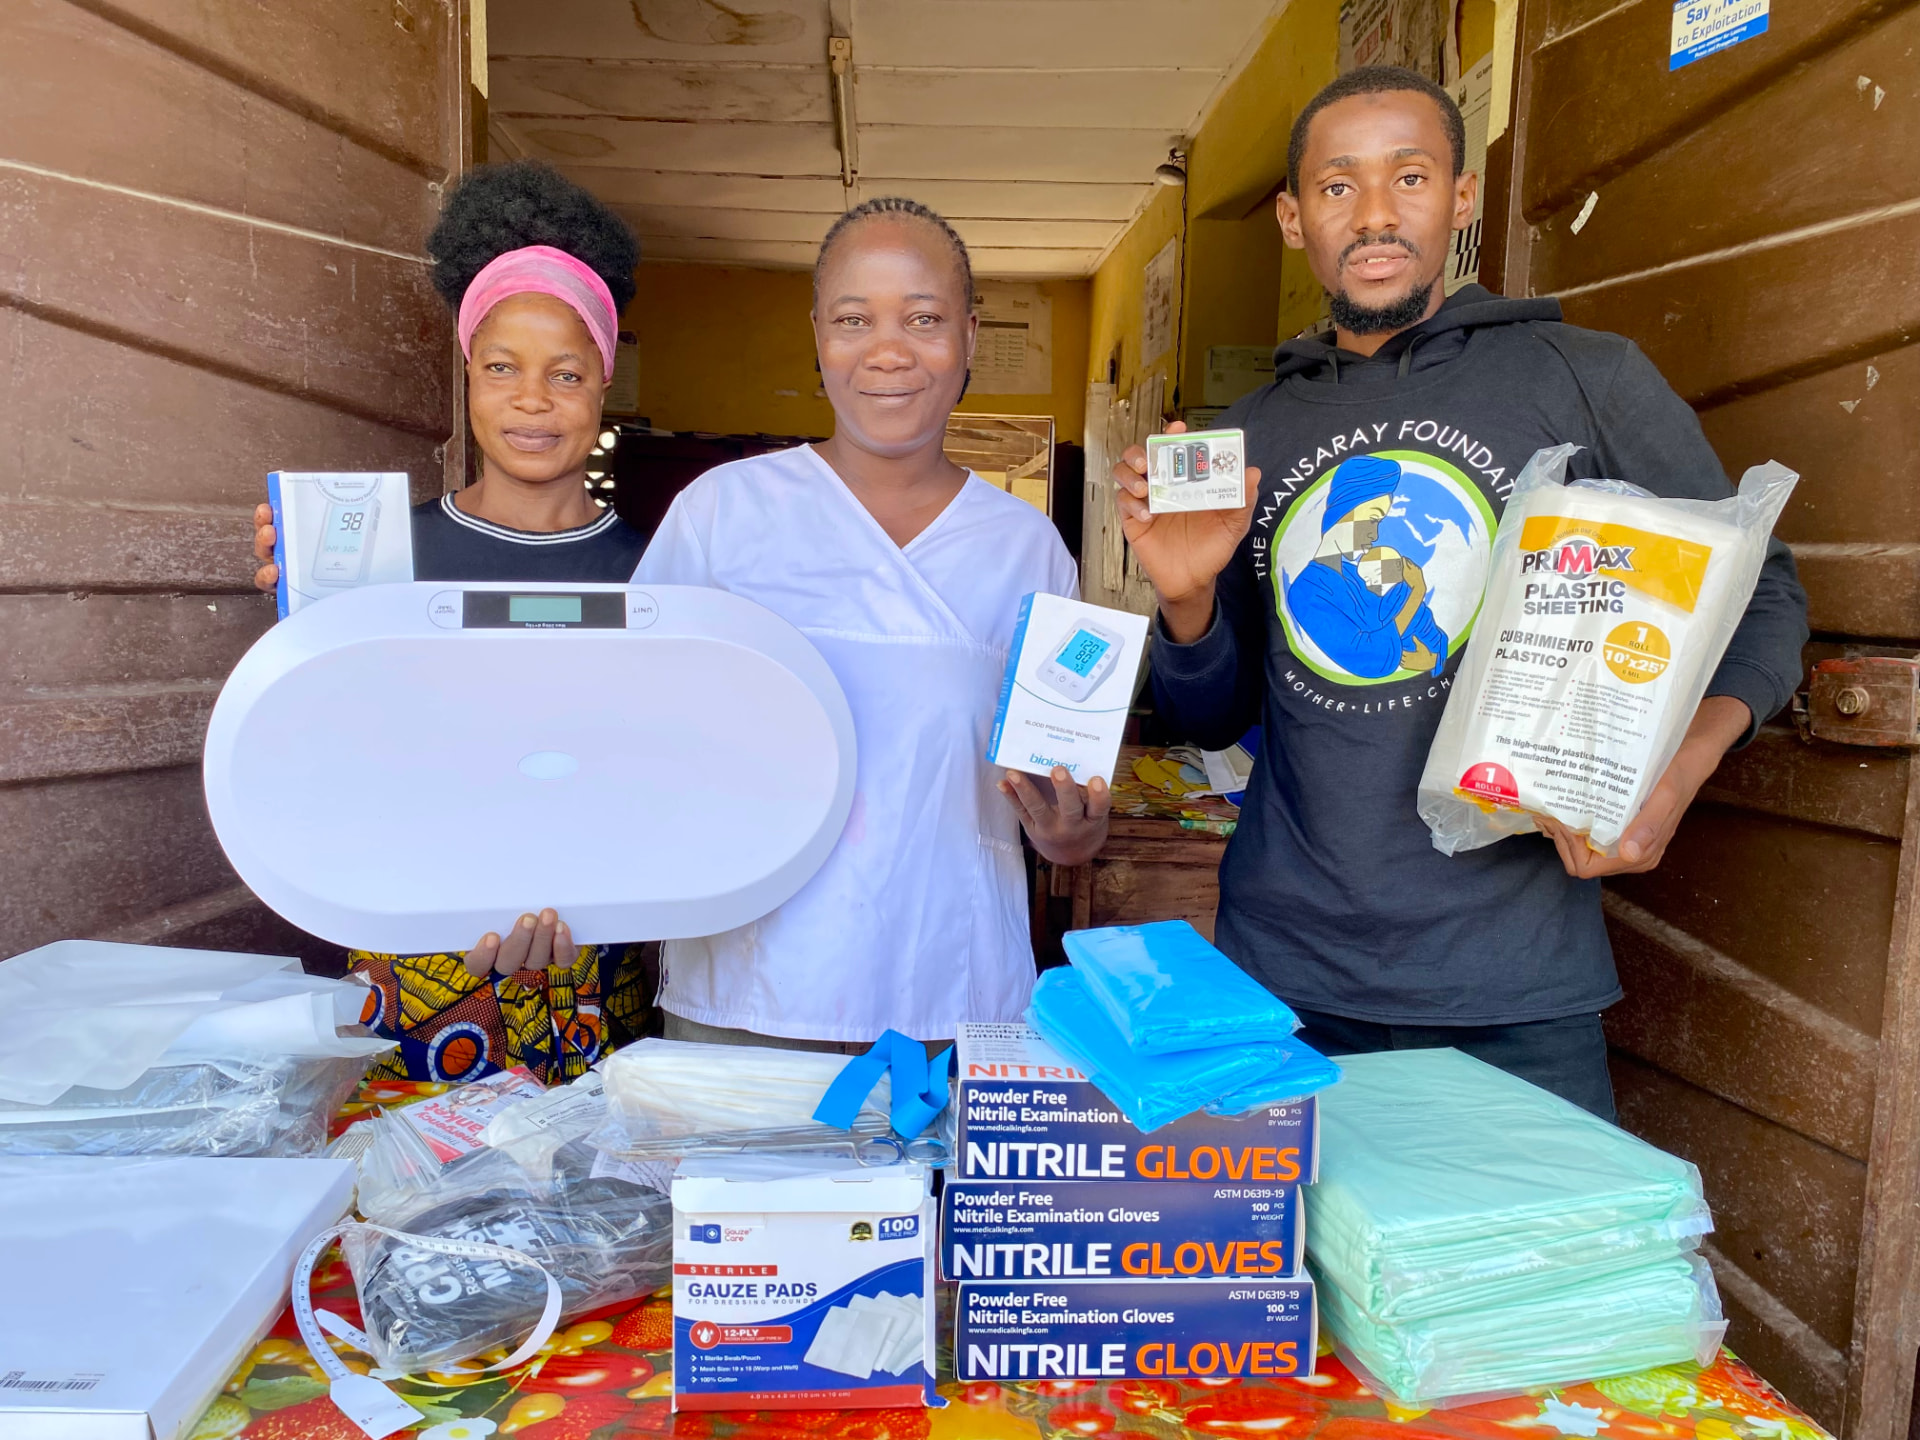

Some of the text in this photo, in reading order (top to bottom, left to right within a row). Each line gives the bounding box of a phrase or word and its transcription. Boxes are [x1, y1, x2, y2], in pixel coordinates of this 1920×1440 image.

[1686, 4, 1711, 25] Say
[1677, 35, 1689, 47] to
[1692, 2, 1761, 39] Exploitation
[1257, 422, 1389, 528] MANSARAY
[1254, 537, 1266, 580] THE
[1522, 544, 1634, 574] PRIMAX
[1525, 581, 1626, 599] PLASTIC
[1524, 599, 1624, 615] SHEETING
[1500, 630, 1594, 653] CUBRIMIENTO
[1636, 627, 1648, 643] 1
[1629, 640, 1650, 652] ROLL
[1075, 651, 1092, 664] 80
[1495, 649, 1568, 669] PLASTICO
[1285, 670, 1346, 712] MOTHER
[1364, 696, 1412, 713] LIFE
[1427, 672, 1458, 698] CH
[1025, 719, 1045, 729] BLOOD
[1045, 724, 1075, 736] PRESSURE
[1075, 730, 1101, 742] MONITOR
[1029, 753, 1077, 772] bioland
[1496, 735, 1511, 745] This
[1513, 740, 1561, 755] high-quality
[1620, 764, 1638, 774] was
[1485, 768, 1496, 783] 1
[1511, 750, 1635, 786] manufactured to absolute
[1475, 782, 1501, 793] ROLLO
[1608, 783, 1630, 797] value.
[968, 1089, 1067, 1105] Powder Free
[968, 1107, 1017, 1122] Nitrile
[1022, 1107, 1118, 1123] Examination
[1268, 1108, 1287, 1117] 100
[415, 1111, 485, 1149] Emergency
[967, 1125, 1048, 1133] www.medicalkingfa.com
[1268, 1119, 1302, 1127] BY WEIGHT
[966, 1142, 1301, 1180] NITRILE GLOVES
[954, 1191, 1053, 1206] Powder Free
[1214, 1189, 1285, 1199] ASTM D6319-19
[1252, 1202, 1285, 1212] 100 PCS
[954, 1208, 1160, 1225] Nitrile Examination Gloves
[1262, 1213, 1284, 1221] WEIGHT
[724, 1228, 750, 1236] Gauze
[881, 1218, 915, 1233] 100
[953, 1226, 1034, 1235] www.medicalkingfa.com
[953, 1240, 1284, 1276] NITRILE GLOVES
[690, 1266, 768, 1275] STERILE
[688, 1283, 818, 1298] GAUZE PADS
[1228, 1289, 1300, 1300] ASTM D6319-19
[968, 1293, 1068, 1308] Powder Free
[1266, 1304, 1285, 1313] 100
[968, 1310, 1175, 1326] Nitrile Examination Gloves
[724, 1329, 760, 1337] 12-PLY
[968, 1327, 1049, 1335] www.medicalkingfa.com
[967, 1341, 1298, 1376] NITRILE GLOVES
